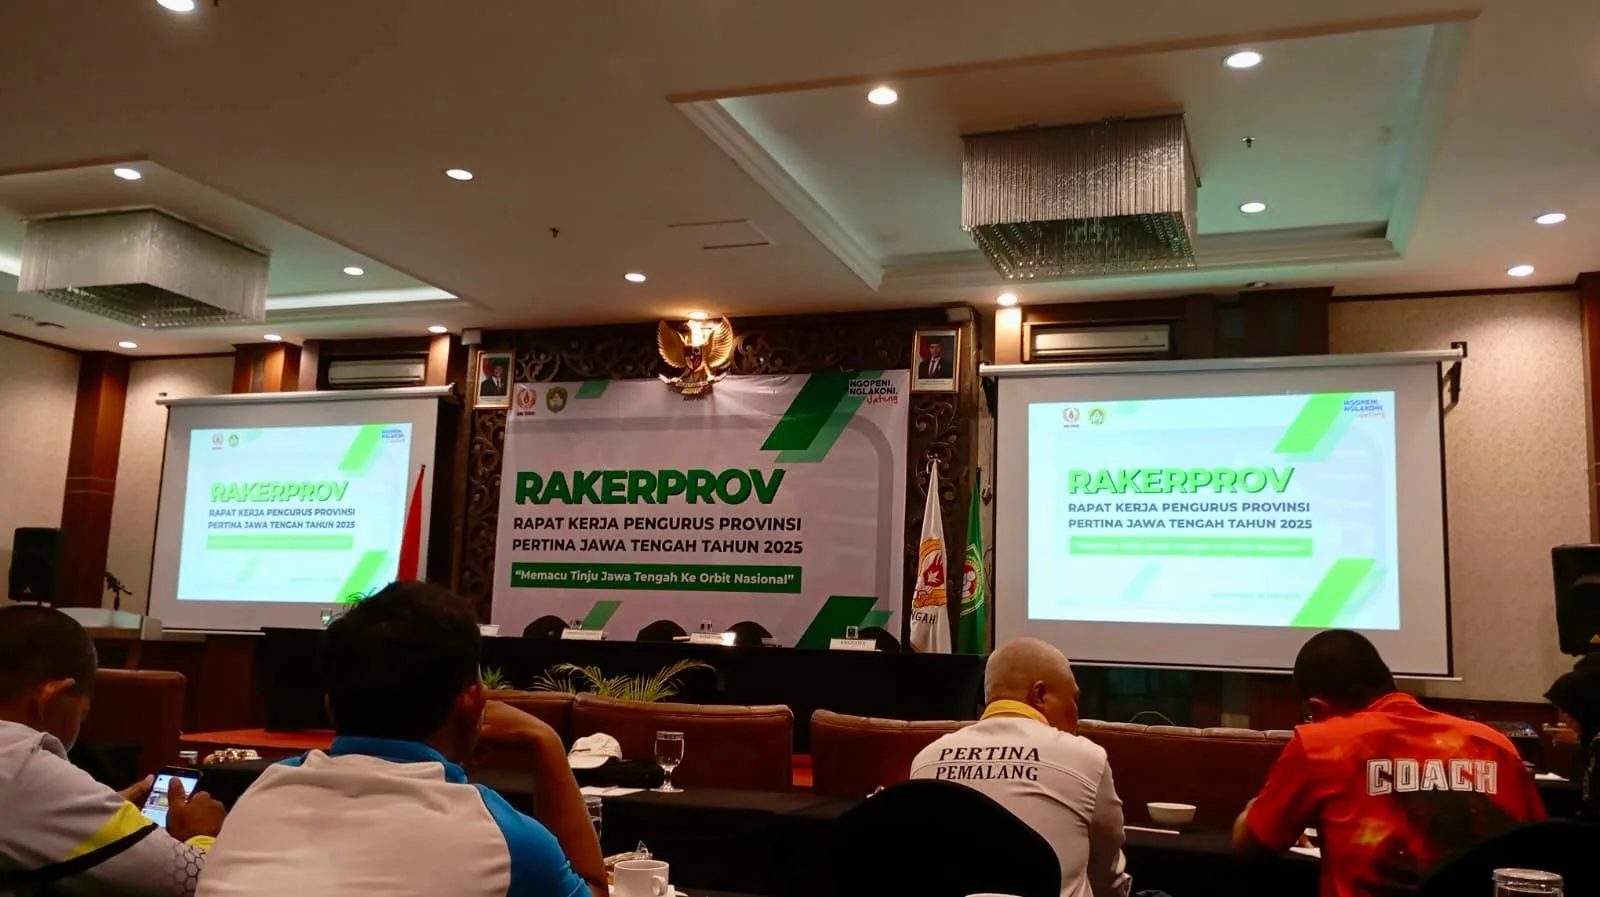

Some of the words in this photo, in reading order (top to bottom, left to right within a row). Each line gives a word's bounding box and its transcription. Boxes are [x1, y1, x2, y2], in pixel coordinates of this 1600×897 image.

[515, 468, 786, 505] RAKERPROV
[1068, 467, 1295, 494] RAKERPROV
[210, 480, 349, 502] RAKERPROV
[209, 509, 236, 517] RAPAT
[239, 509, 265, 517] KERJA
[266, 508, 313, 517] PENGURUS
[314, 508, 356, 516] PROVINSI
[1068, 503, 1112, 513] RAPAT
[1115, 503, 1158, 513] KERJA
[1162, 502, 1238, 513] PENGURUS
[1242, 502, 1310, 513] PROVINSI
[208, 521, 242, 529] PERTINA
[244, 521, 268, 529] JAWA
[305, 521, 334, 529] TAHUN
[336, 521, 356, 529] 2025
[513, 517, 564, 530] RAPAT
[568, 517, 619, 530] KERJA
[623, 517, 715, 530] PENGURUS
[719, 517, 801, 531] PROVINSI
[1068, 519, 1123, 529] PERTINA
[1126, 519, 1166, 529] JAWA
[1169, 519, 1224, 529] TENGAH
[1228, 519, 1276, 529] TAHUN
[1280, 519, 1312, 529] 2025
[512, 539, 576, 551] PERTINA
[579, 539, 626, 552] JAWA
[631, 539, 697, 553] TENGAH
[701, 540, 759, 553] TAHUN
[763, 541, 803, 554] 2025
[570, 570, 598, 583] Tinju
[601, 571, 631, 582] Jawa
[634, 571, 678, 584] Tengah
[681, 572, 697, 583] Ke
[699, 571, 731, 583] Orbit
[939, 746, 1041, 762] PERTINA
[936, 765, 1038, 781] PEMALANG
[1366, 758, 1498, 796] COACH
